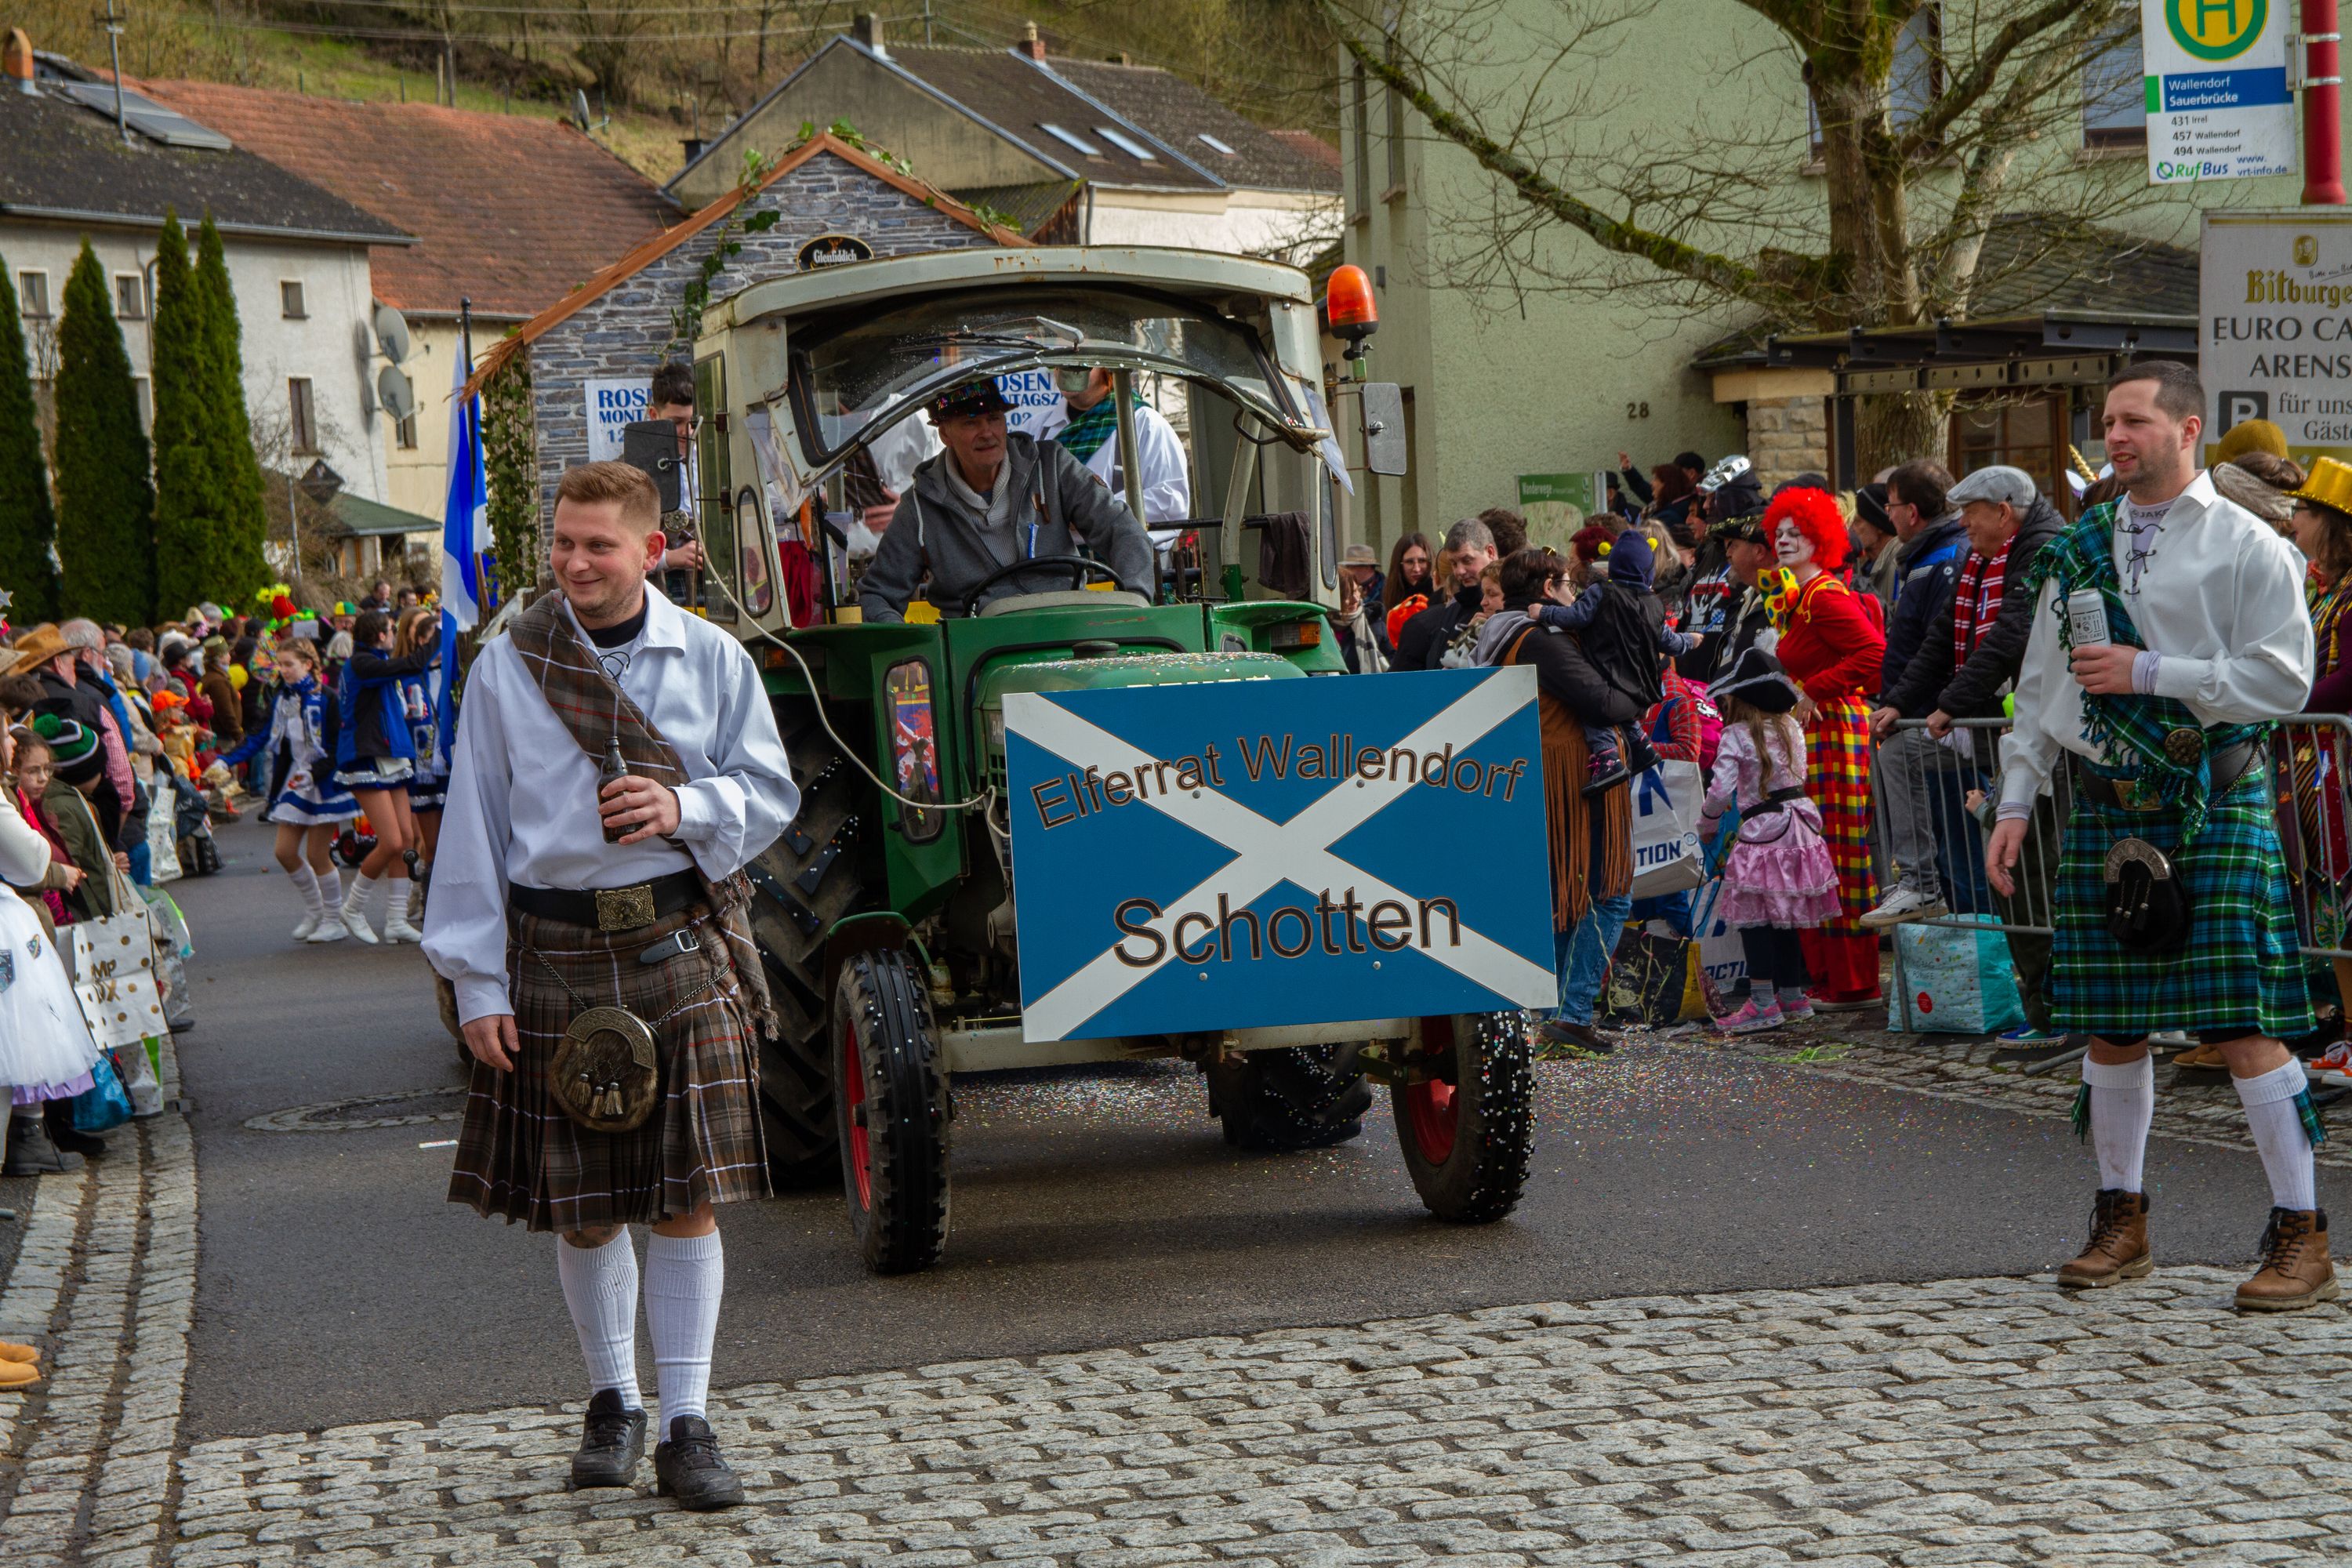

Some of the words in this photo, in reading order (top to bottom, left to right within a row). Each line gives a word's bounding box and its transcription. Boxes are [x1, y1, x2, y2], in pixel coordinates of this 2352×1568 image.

[2169, 76, 2230, 91] Wallendorf
[2169, 92, 2238, 107] Sauerbrücke
[2171, 115, 2189, 126] 431
[2191, 115, 2208, 124] Irrel
[2172, 131, 2191, 141] 457
[2195, 129, 2241, 140] Wallendorf
[2173, 147, 2193, 156] 494
[2196, 145, 2242, 155] Wallendorf
[2176, 162, 2228, 181] RufBus
[2238, 165, 2288, 176] vrt-info.de
[814, 248, 858, 263] Glenfiddich
[2213, 316, 2303, 342] EURO
[2249, 354, 2352, 379] ARENS
[1627, 401, 1649, 419] 28
[2278, 393, 2310, 415] für
[598, 408, 650, 423] MONT
[1029, 742, 1226, 831] Elferrat
[1236, 733, 1529, 803] Wallendorf
[1112, 886, 1461, 969] Schotten
